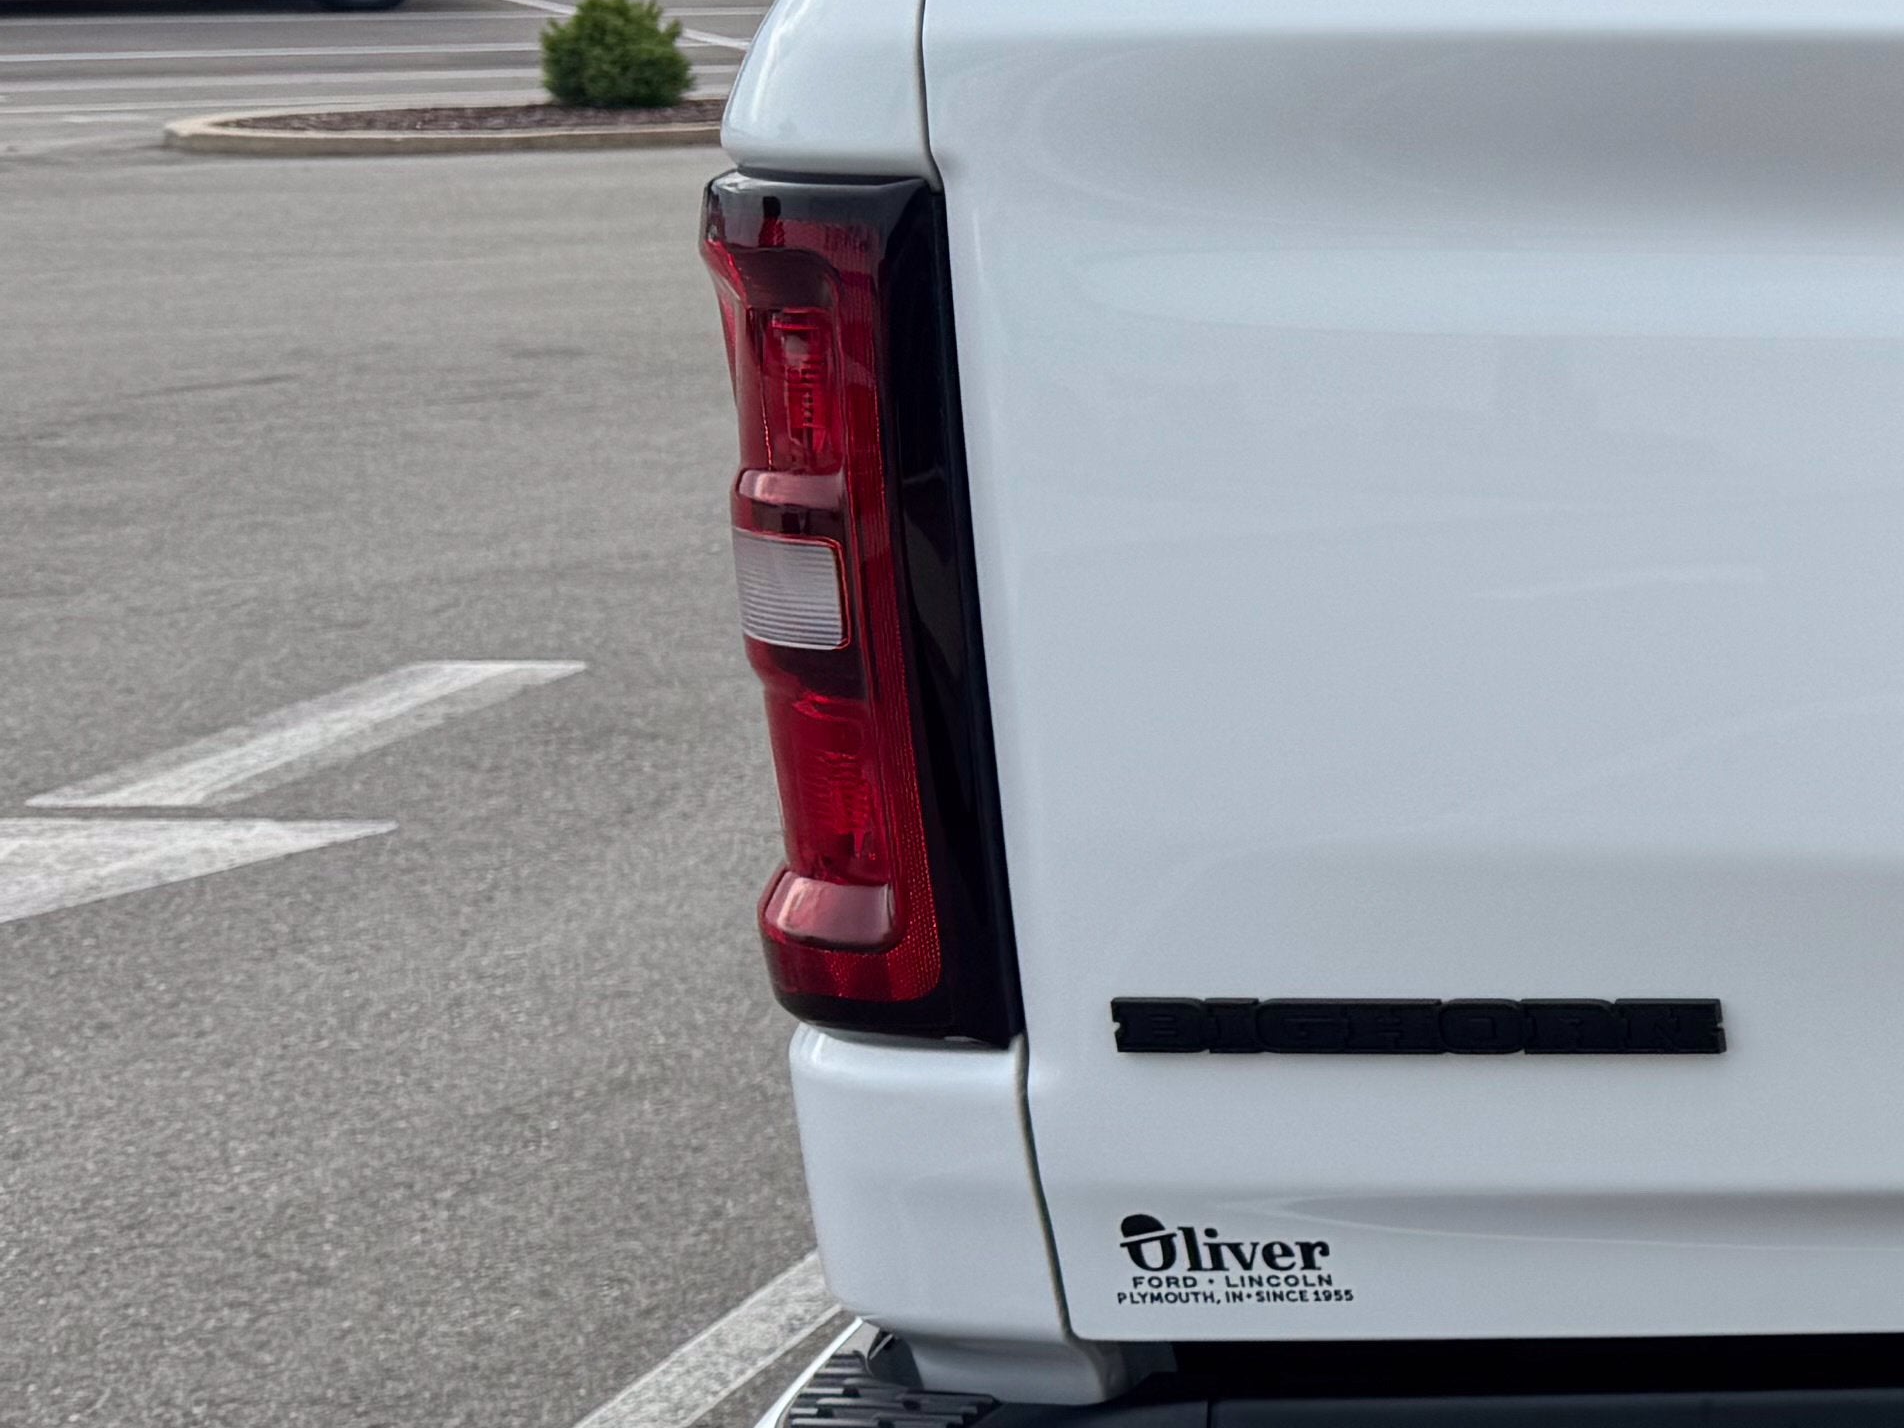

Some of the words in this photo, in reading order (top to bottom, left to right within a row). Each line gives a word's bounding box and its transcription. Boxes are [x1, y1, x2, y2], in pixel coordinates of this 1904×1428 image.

[1120, 1214, 1330, 1271] Oliver
[1132, 1275, 1198, 1288] FORD
[1225, 1274, 1333, 1287] LINCOLN
[1117, 1291, 1221, 1304] PLYMOUTH,
[1313, 1289, 1354, 1302] 1955
